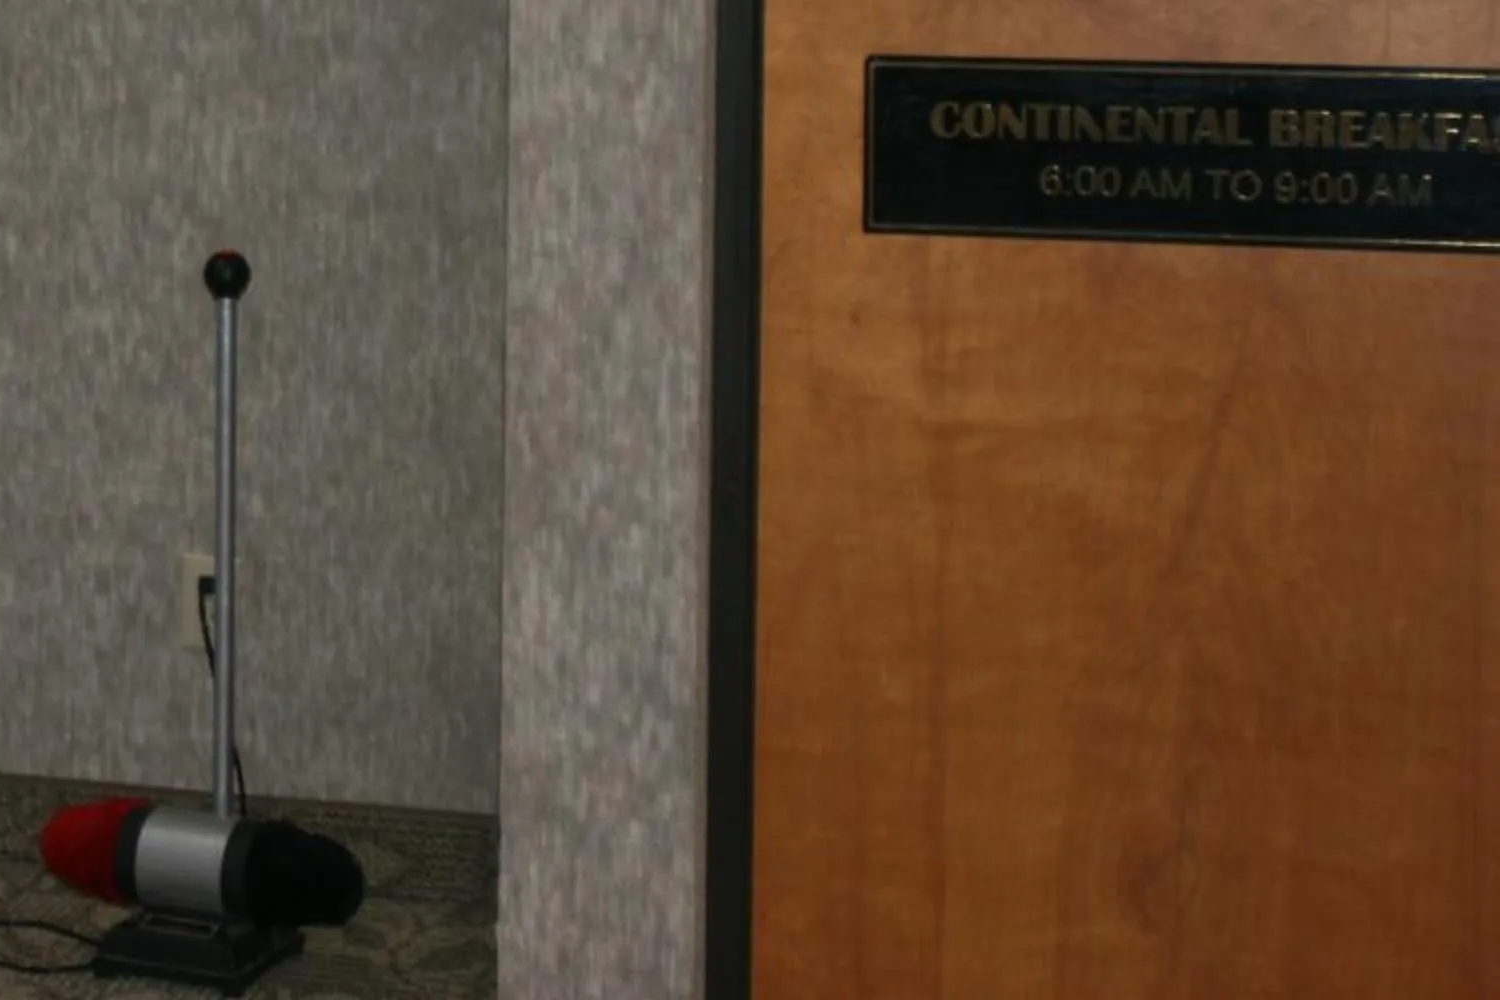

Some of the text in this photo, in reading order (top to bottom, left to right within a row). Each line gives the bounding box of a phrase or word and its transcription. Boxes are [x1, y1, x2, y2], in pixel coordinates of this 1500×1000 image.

[928, 101, 1253, 148] CONTINENTAL
[1038, 163, 1434, 208] 6:00 AM TO 9:00 AM
